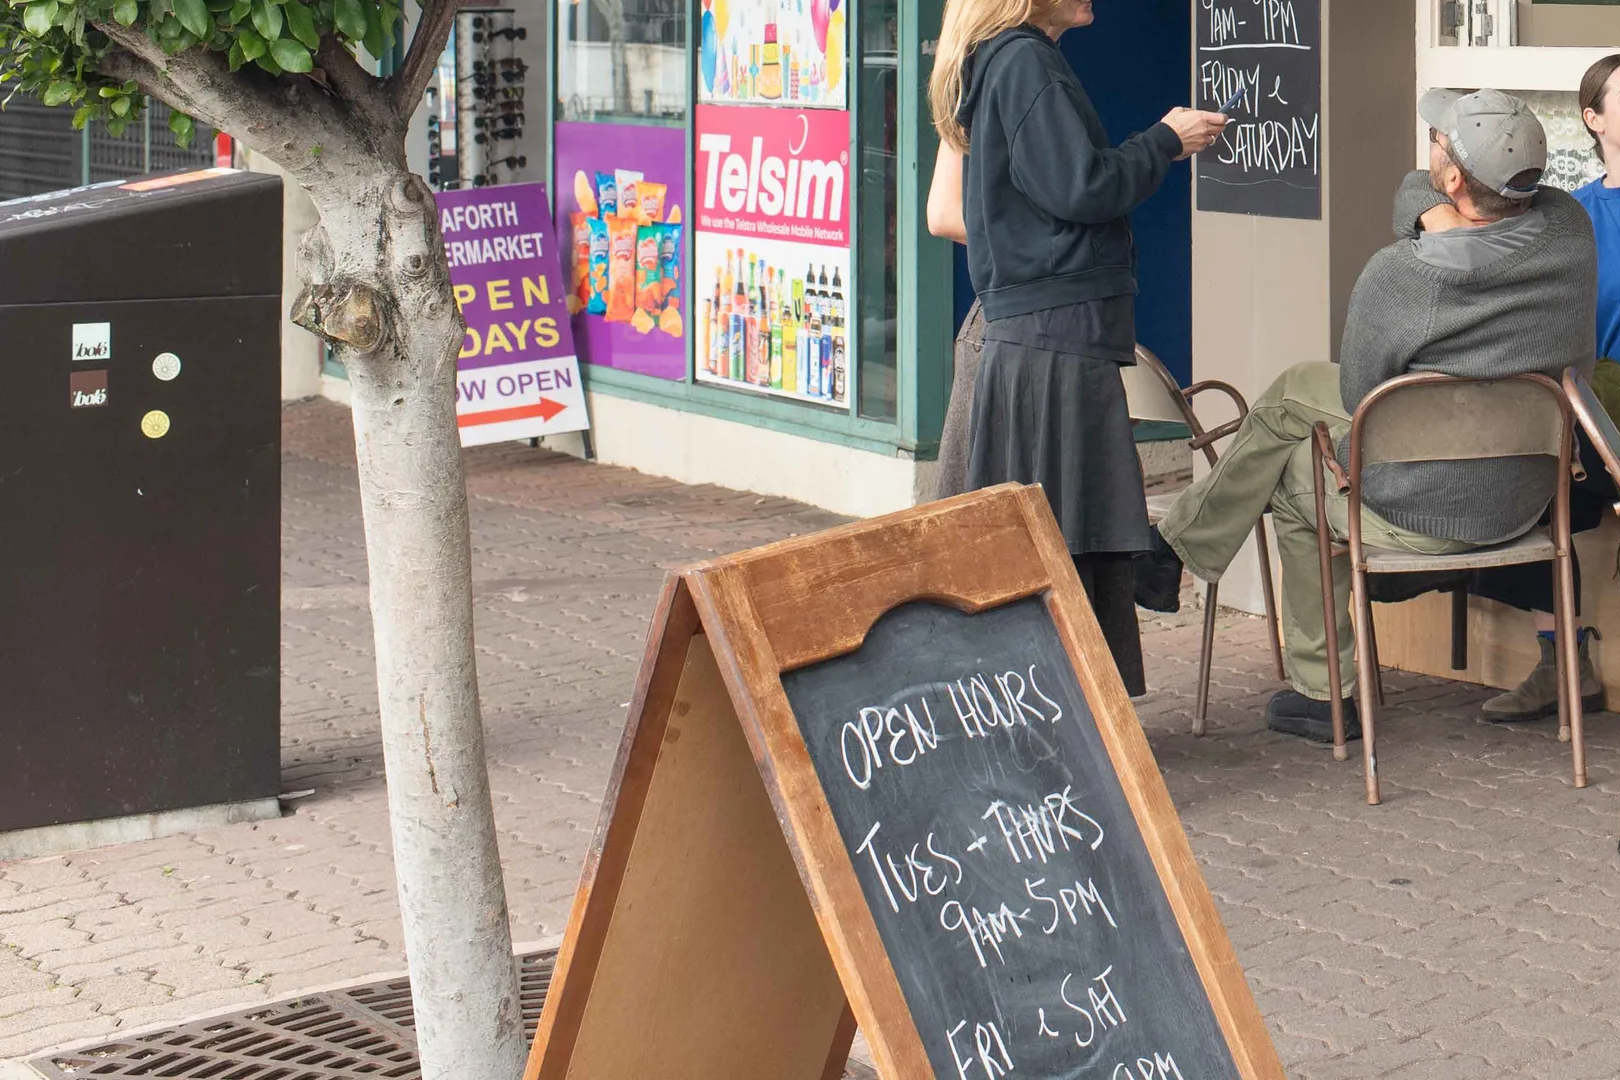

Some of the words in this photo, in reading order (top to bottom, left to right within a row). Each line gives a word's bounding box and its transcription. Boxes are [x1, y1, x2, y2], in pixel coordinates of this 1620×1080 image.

[1201, 60, 1261, 118] FRIDAY
[1217, 112, 1320, 177] SATURDAY
[700, 133, 845, 222] Telsim
[440, 201, 519, 233] AFORTH
[700, 215, 712, 228] We
[724, 218, 735, 230] the
[814, 226, 844, 242] Network
[444, 232, 543, 268] RMARKET
[454, 275, 550, 315] PEN
[458, 317, 560, 359] DAYS
[496, 368, 572, 397] OPEN
[840, 697, 938, 791] OPEN
[948, 663, 1063, 738] HOURS
[856, 820, 963, 914] TUES
[981, 784, 1104, 864] THURS
[946, 1019, 1016, 1080] FRI
[1060, 964, 1128, 1048] SAT
